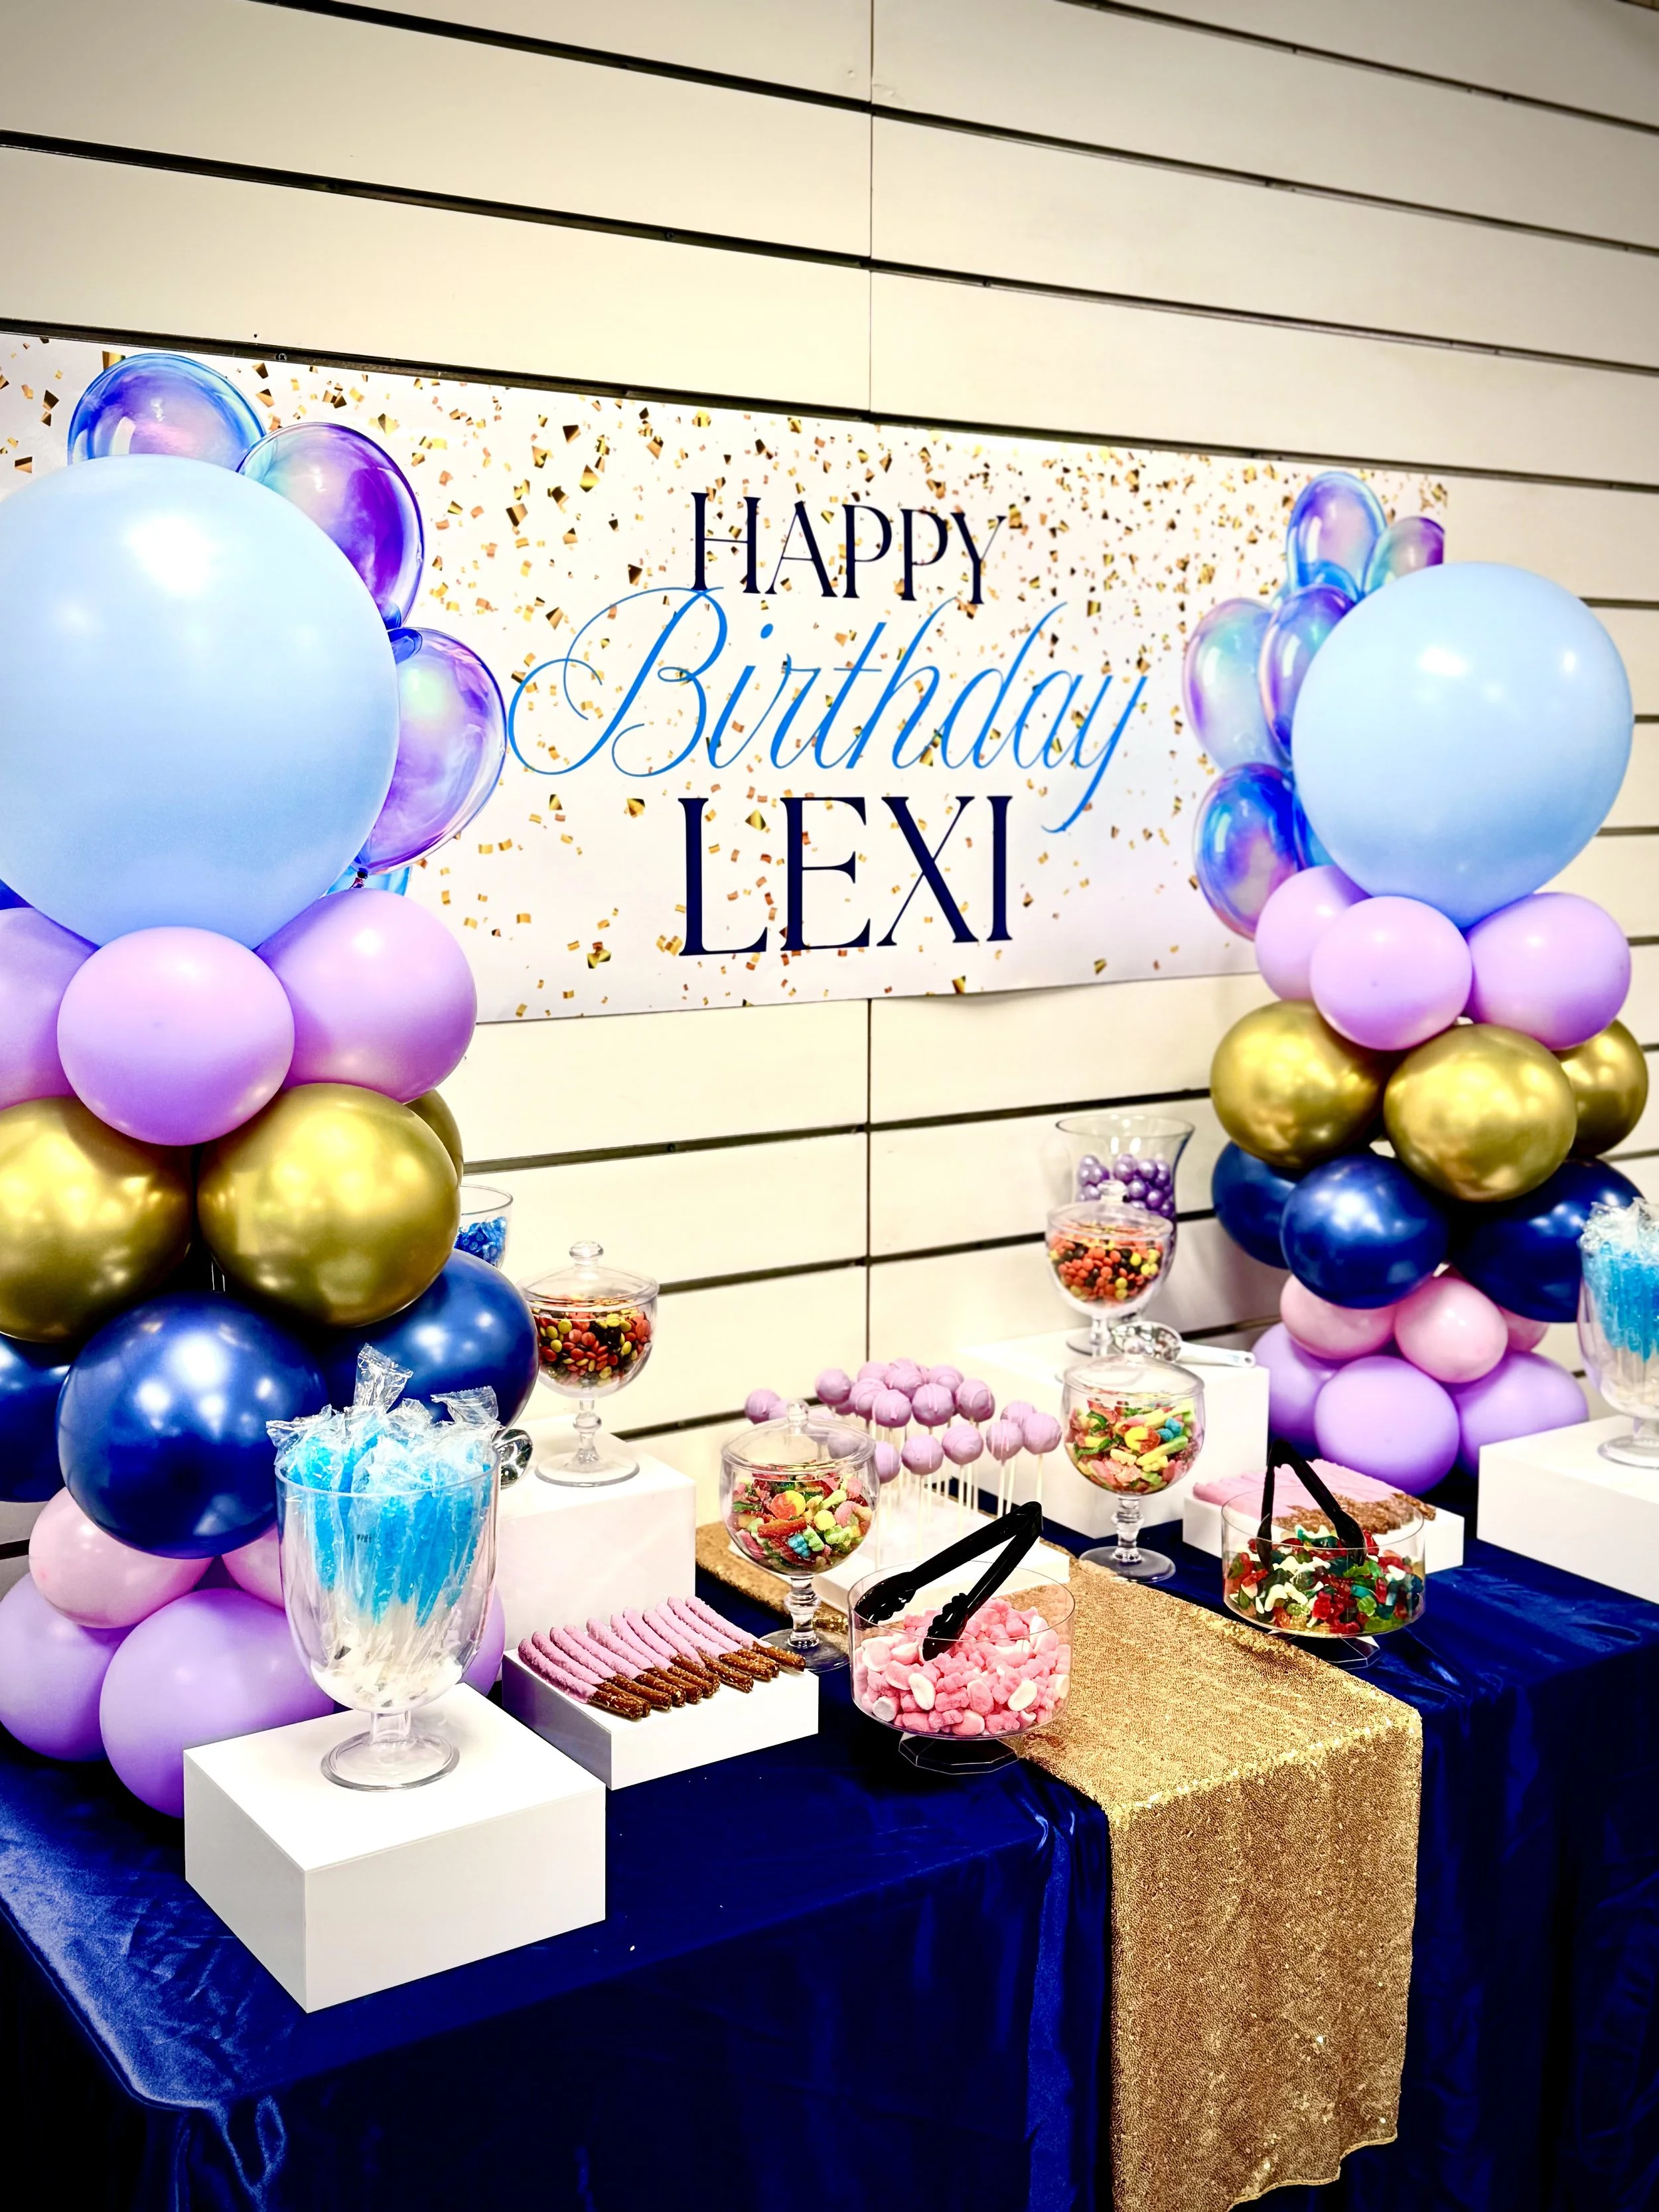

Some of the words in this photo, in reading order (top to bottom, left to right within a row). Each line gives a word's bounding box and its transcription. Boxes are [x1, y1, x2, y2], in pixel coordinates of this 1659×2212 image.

[690, 492, 1007, 605] HAPPY
[507, 586, 1148, 833] Birthday
[678, 796, 1013, 956] LEXI
